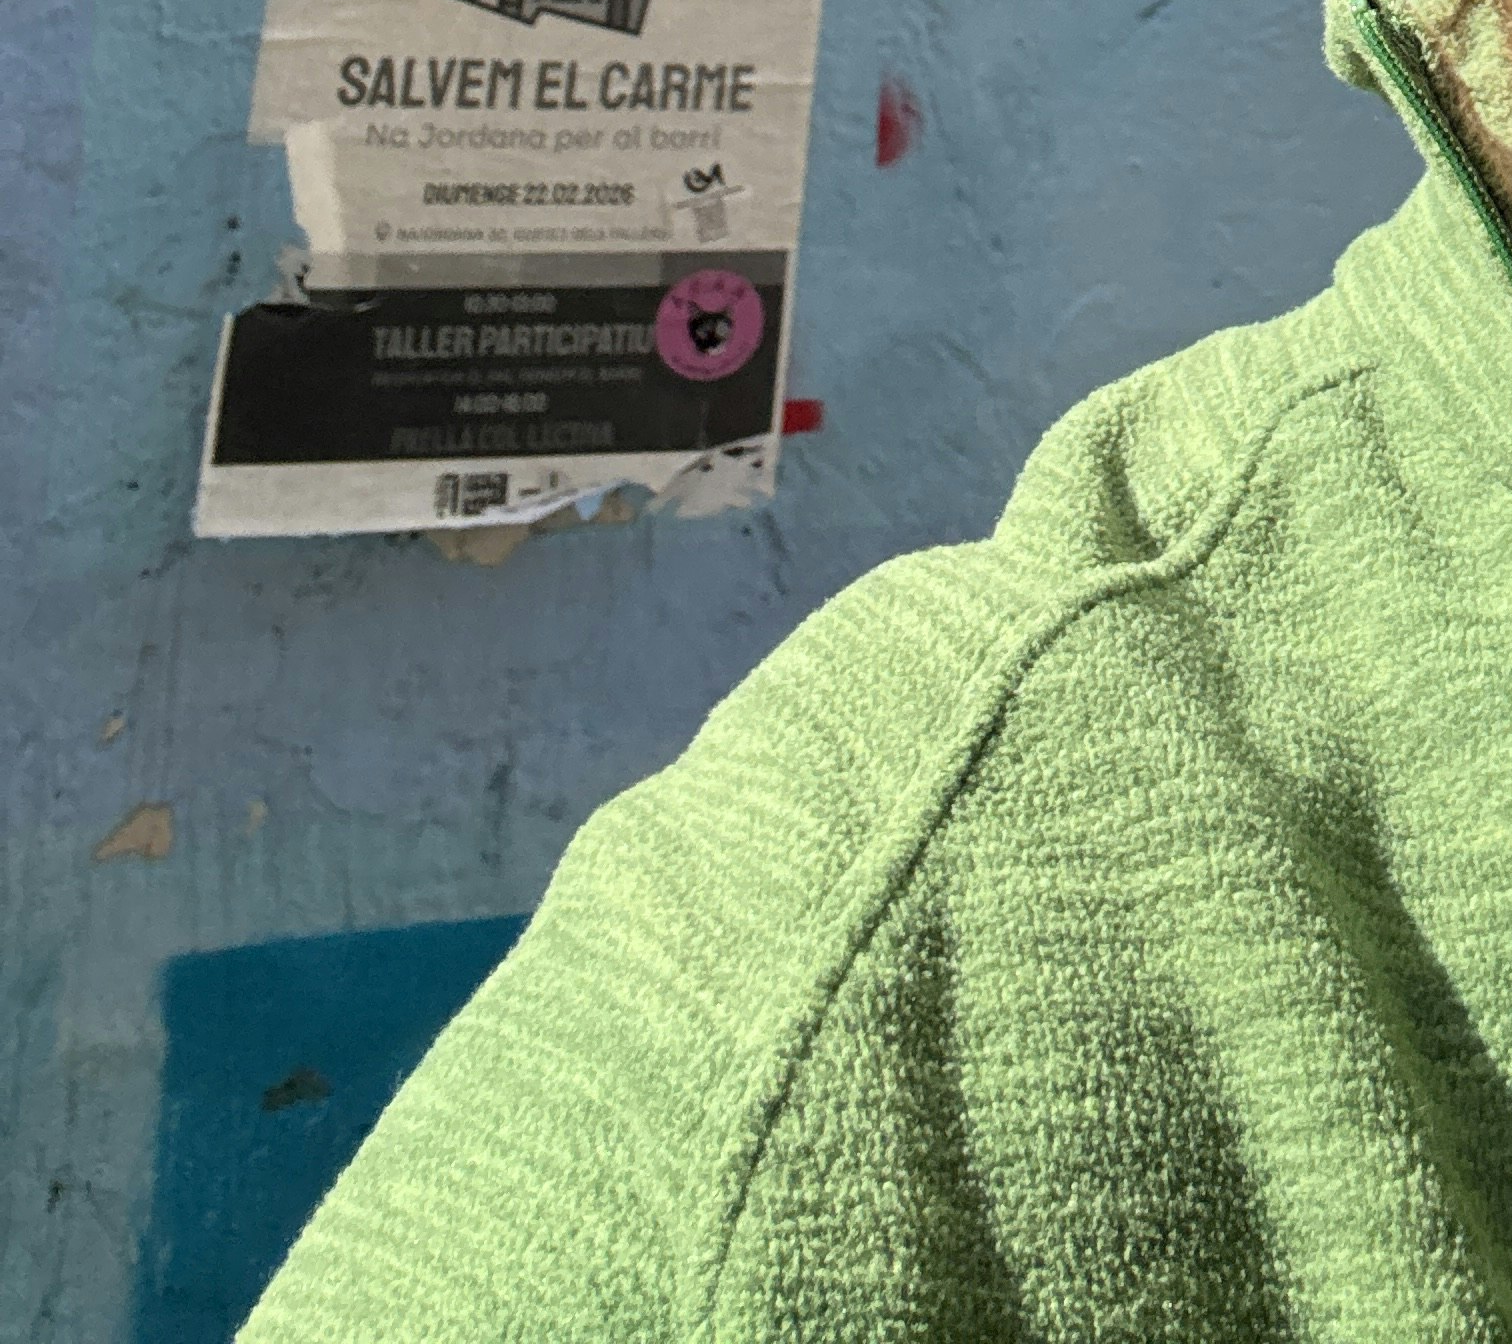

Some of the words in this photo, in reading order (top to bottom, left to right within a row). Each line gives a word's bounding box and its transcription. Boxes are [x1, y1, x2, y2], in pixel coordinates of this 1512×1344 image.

[337, 55, 523, 109] SALVEM
[535, 60, 588, 110] EL
[600, 61, 757, 111] CARME
[365, 122, 409, 149] Na
[417, 122, 547, 150] Jordana
[553, 126, 604, 153] per
[649, 123, 721, 150] barri
[373, 326, 476, 359] TALLER
